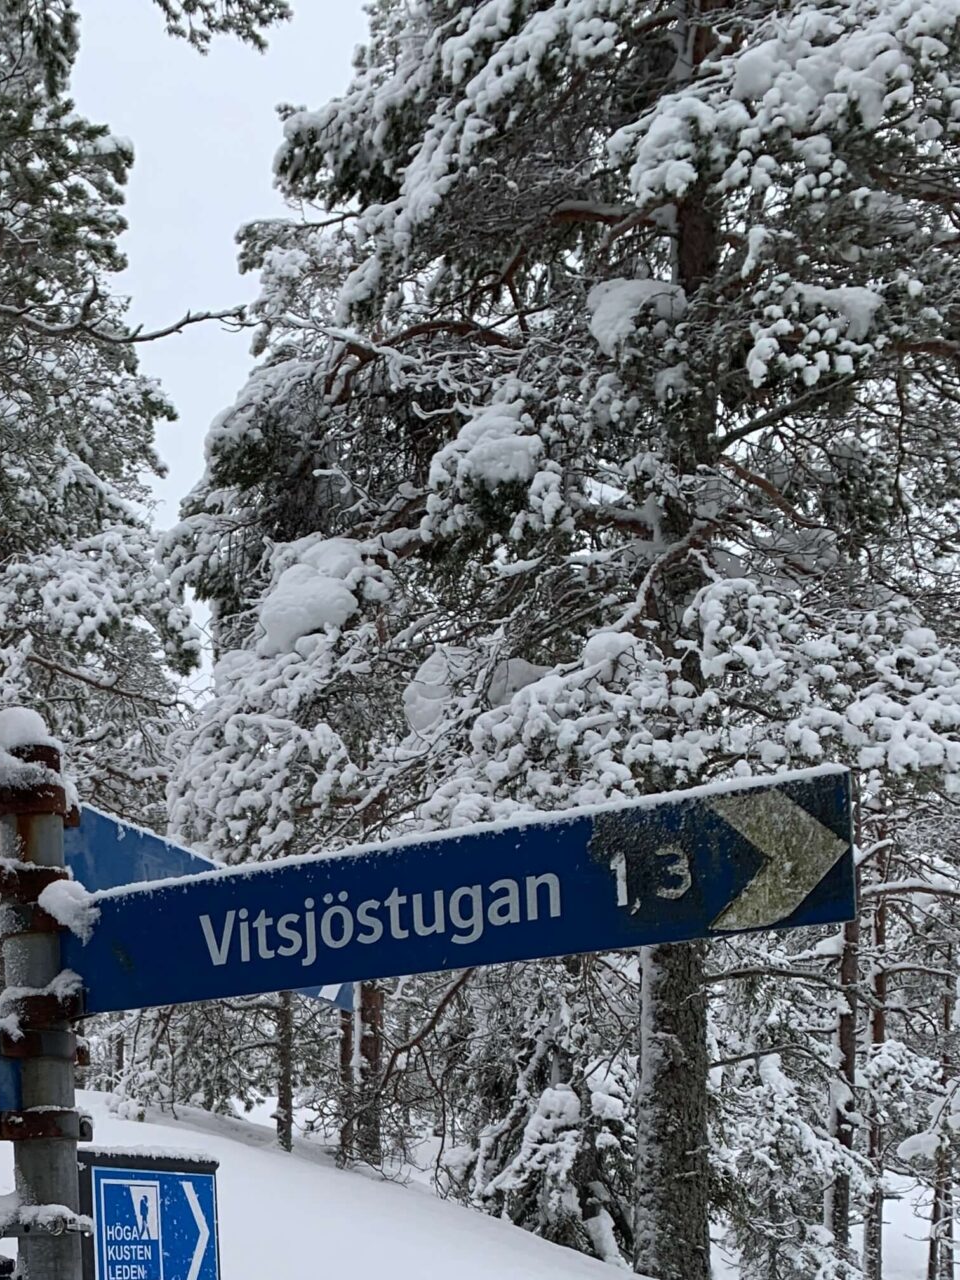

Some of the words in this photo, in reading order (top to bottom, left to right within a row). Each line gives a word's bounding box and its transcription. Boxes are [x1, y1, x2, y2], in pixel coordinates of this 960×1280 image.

[199, 872, 562, 967] Vitsjöstugan
[106, 1223, 139, 1240] HÖGA
[107, 1245, 151, 1260] KUSTEN
[108, 1265, 145, 1280] LEDEN
